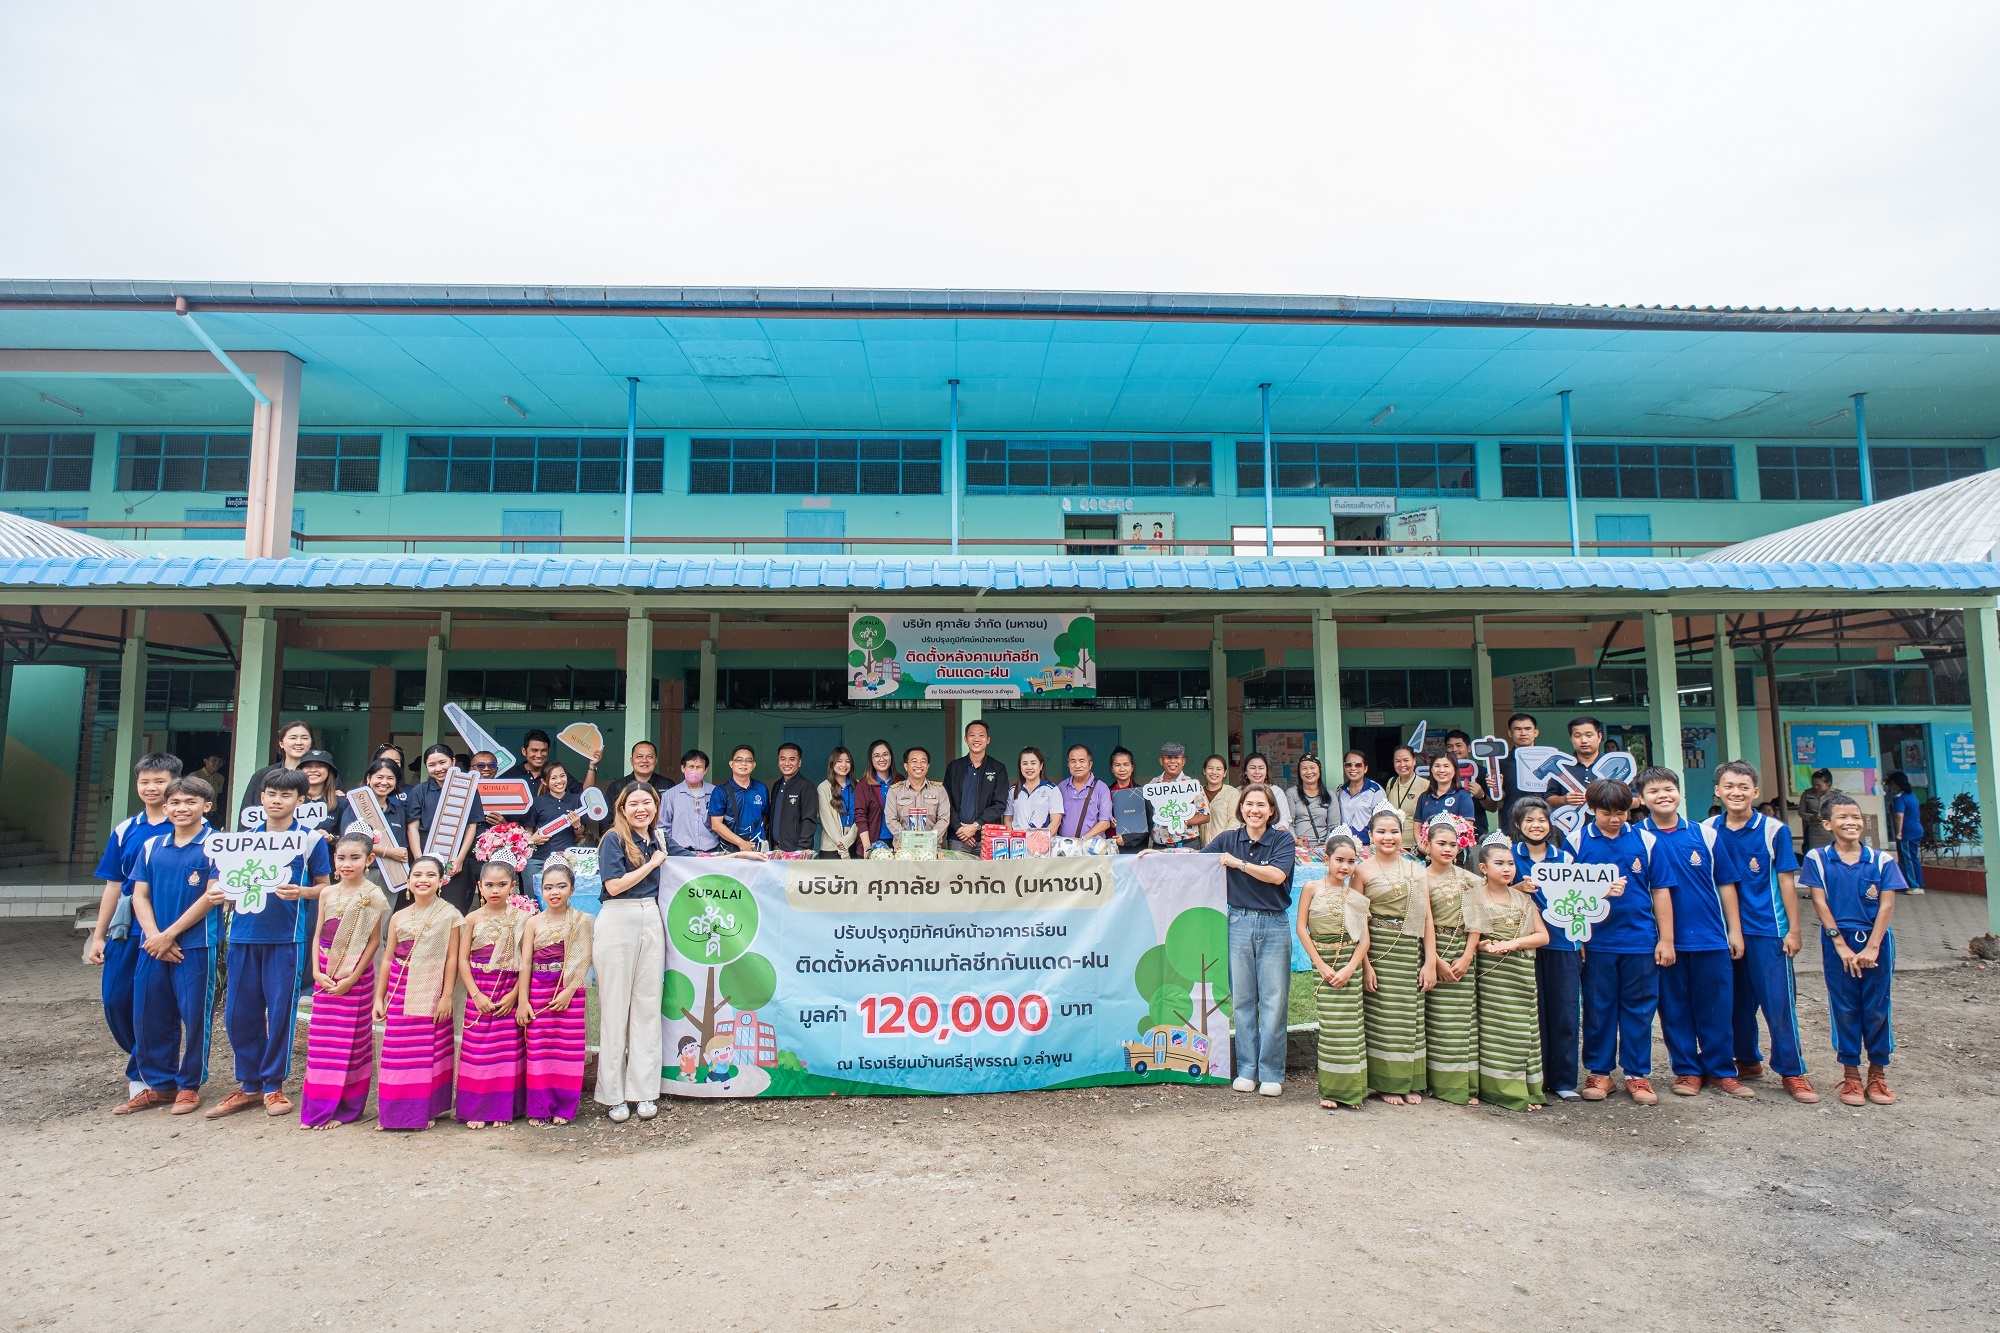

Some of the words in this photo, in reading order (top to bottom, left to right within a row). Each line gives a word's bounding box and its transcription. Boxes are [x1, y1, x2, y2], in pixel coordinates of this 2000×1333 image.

[902, 618, 932, 629] บริษัท
[935, 618, 970, 632] ศุภาลัย
[975, 618, 1002, 629] จำกัด
[1005, 619, 1048, 631] (มหาชน)
[921, 635, 1025, 645] ปรับปรุงภูมิทัศน์หน้าอาคารเรียน
[905, 646, 1040, 663] ติดตั้งหลังคาเมทัลชีท
[936, 665, 1010, 678] กันแดด-ฝน
[1146, 783, 1198, 797] SUPALAI
[211, 835, 302, 852] SUPALAI
[1537, 868, 1614, 883] SUPALAI
[687, 887, 742, 900] SUPALAI
[798, 875, 858, 896] บริษัท
[867, 876, 941, 901] ศุภาลัย
[949, 875, 1006, 895] จำกัด
[1015, 872, 1103, 897] (มหาชน)
[833, 922, 1067, 944] ปรับปรุงภูมิทัศน์หน้าอาคารเรียน
[795, 949, 1109, 973] ติดตั้งหลังคาเมทัลชีทกันแดด-ฝน
[799, 1004, 847, 1028] มูลค่า
[860, 994, 1049, 1040] 120,000
[1060, 1002, 1093, 1017] บาท
[837, 1059, 853, 1071] ณ
[858, 1054, 1018, 1072] โรงเรียนบ้านศรีสุพรรณ
[1023, 1050, 1073, 1068] จ.ลำพูน
